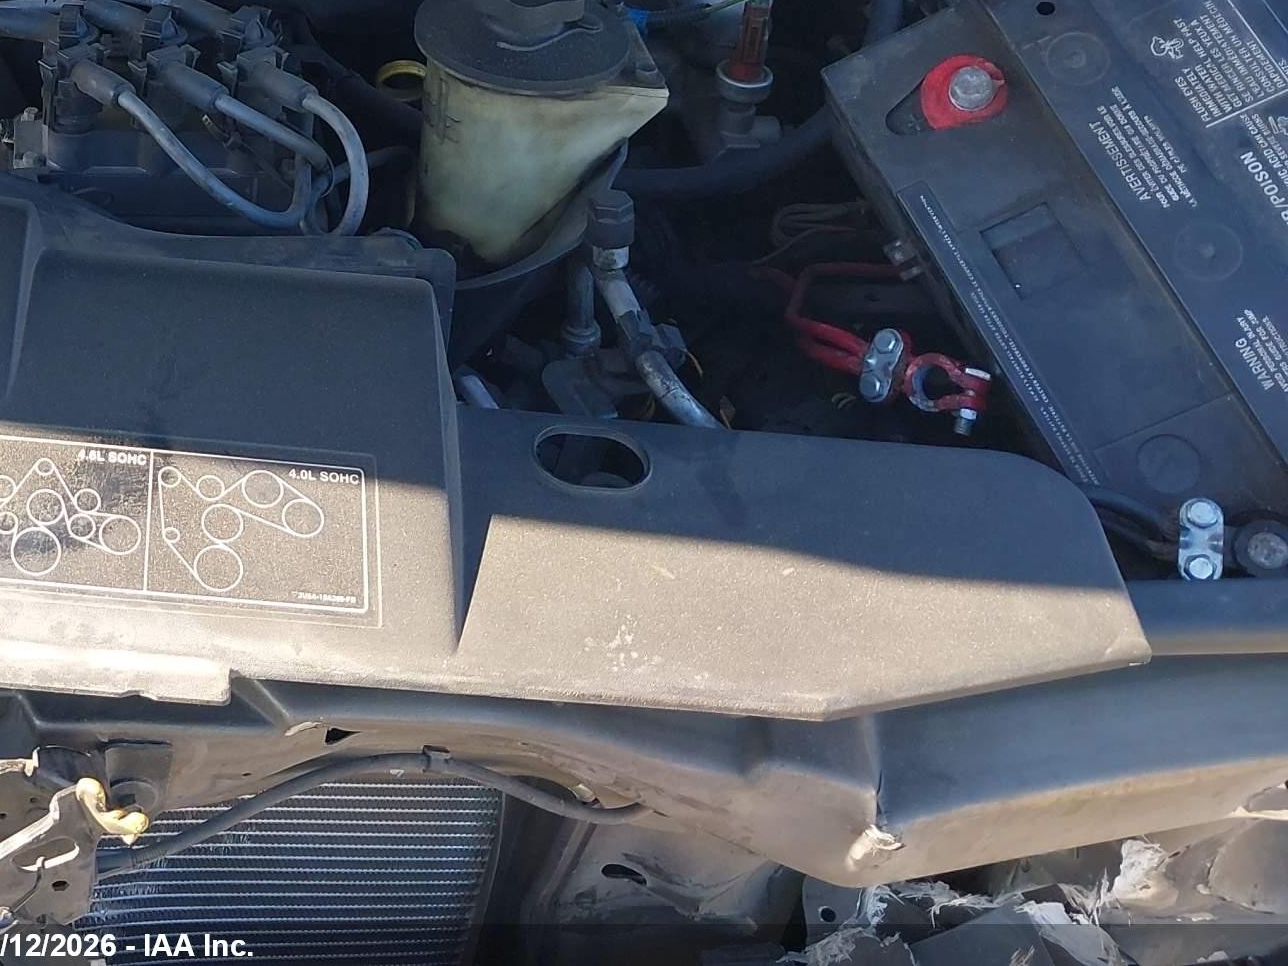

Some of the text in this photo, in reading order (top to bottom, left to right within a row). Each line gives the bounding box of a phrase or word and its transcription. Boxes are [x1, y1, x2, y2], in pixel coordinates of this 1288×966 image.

[1193, 24, 1213, 48] YEUX
[1202, 0, 1275, 93] CONSULTER UN MÉDECIN
[1172, 17, 1243, 108] GET MEDICAL HELP FAST
[1208, 46, 1226, 63] LES
[1245, 39, 1286, 88] RAPIDEMENT
[1180, 66, 1223, 118] IMMEDIATELY
[1193, 63, 1233, 113] WITH WATER
[1240, 89, 1254, 103] SE
[1243, 74, 1265, 98] L'EAU
[1173, 75, 1212, 122] FLUSH EYES
[1253, 132, 1268, 148] CAN
[1087, 120, 1152, 201] AVERTISSEMENT
[1262, 147, 1283, 168] ACID
[1254, 325, 1269, 341] FOR
[1234, 336, 1275, 390] WARNING
[78, 448, 146, 465] 4.6L SOHC
[288, 468, 359, 485] 4.0L SOHC
